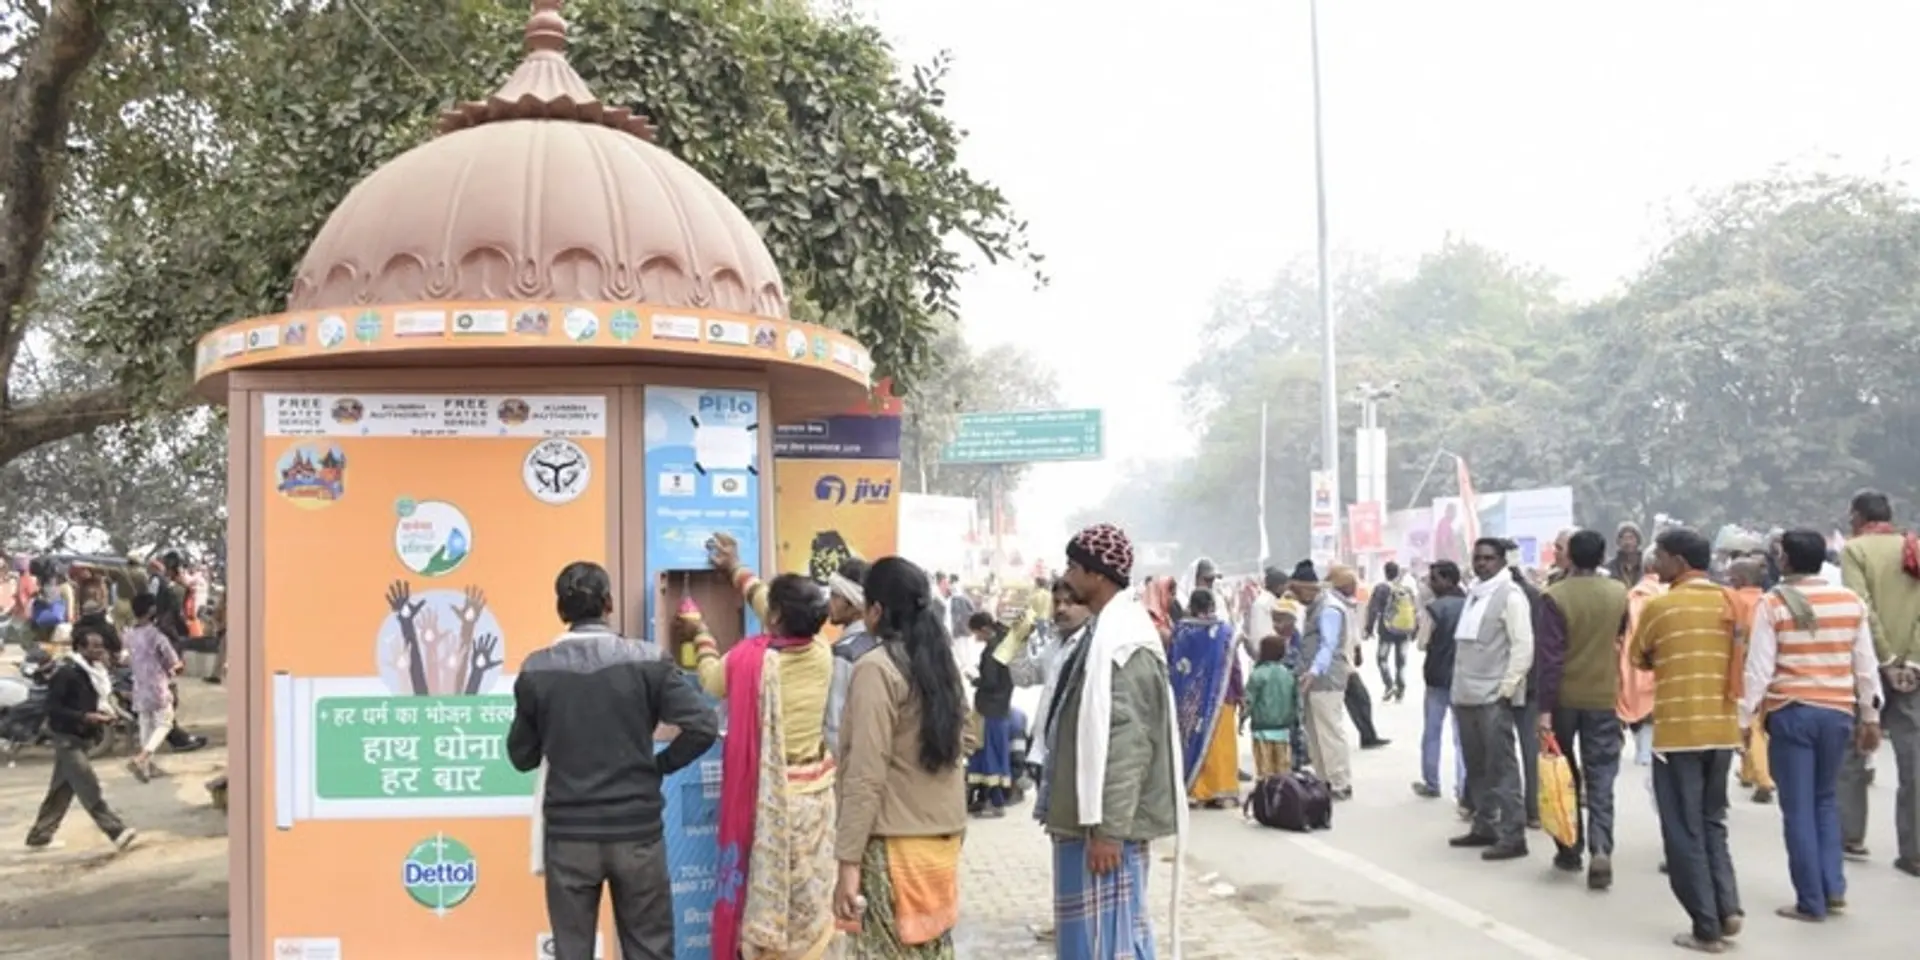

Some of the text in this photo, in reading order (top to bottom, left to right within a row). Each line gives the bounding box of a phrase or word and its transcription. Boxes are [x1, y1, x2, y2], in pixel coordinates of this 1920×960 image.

[278, 398, 321, 409] FREE
[443, 398, 488, 409] FREE
[278, 419, 321, 427] SERVICE
[371, 411, 437, 419] AUTHORITY
[443, 419, 488, 427] SERVICE
[851, 477, 892, 504] jivi
[333, 707, 356, 725] हर
[362, 701, 390, 725] धर्म
[394, 706, 419, 724] का
[424, 701, 472, 724] भोजन
[361, 726, 502, 765] हाथ धोना
[381, 765, 486, 795] हर बार
[405, 862, 474, 885] Dettol
